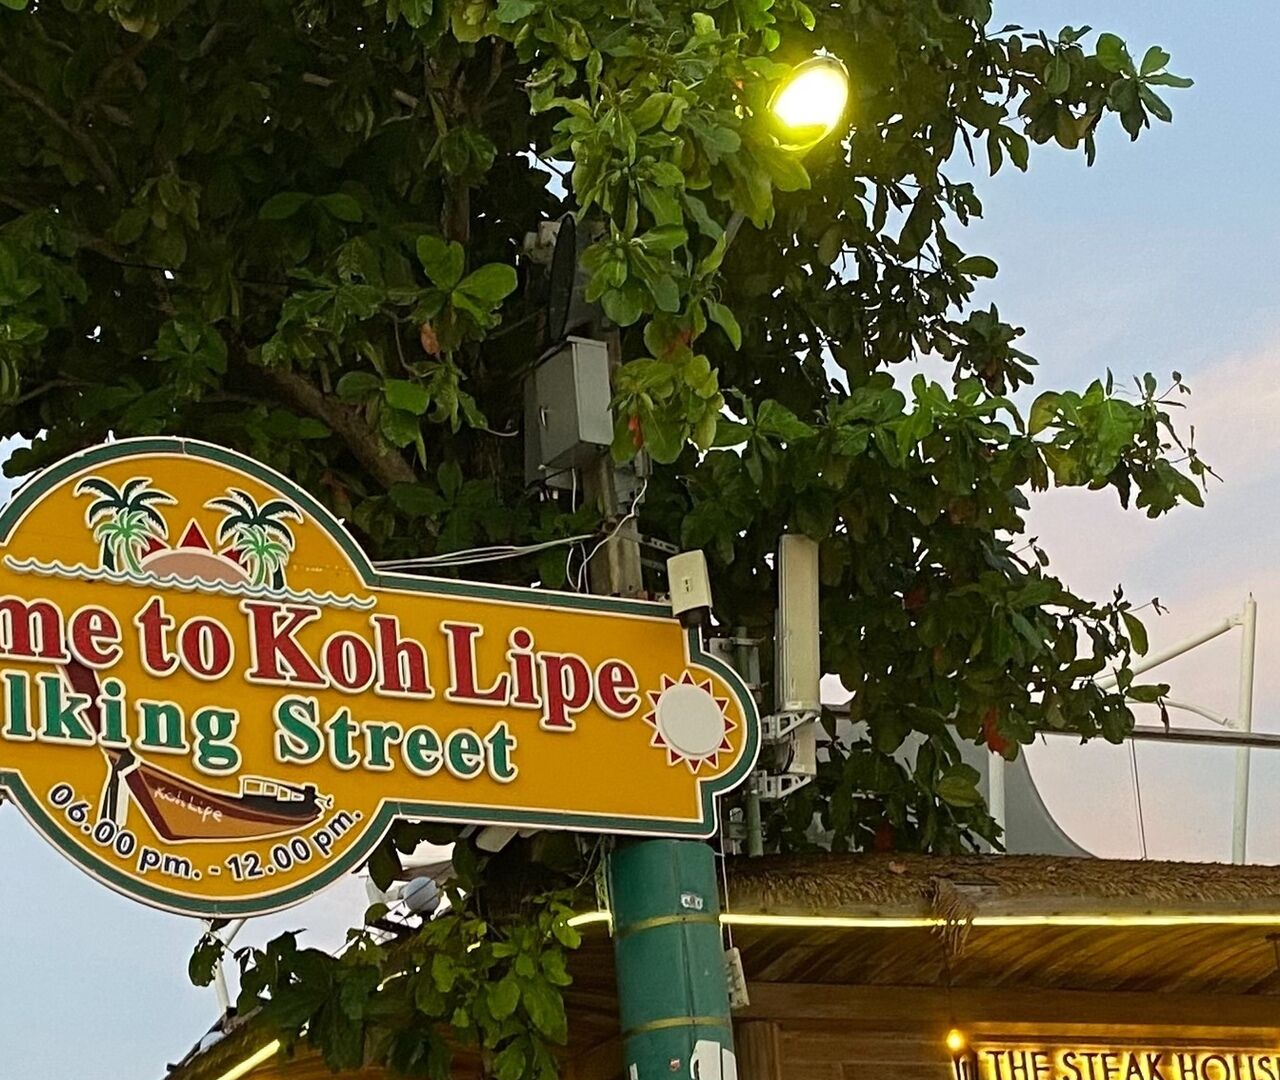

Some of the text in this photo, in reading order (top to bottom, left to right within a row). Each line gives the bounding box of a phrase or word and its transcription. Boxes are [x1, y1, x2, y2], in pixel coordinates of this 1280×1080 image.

[134, 596, 233, 682] to
[240, 598, 435, 700] Koh
[441, 620, 641, 732] Lipe
[272, 694, 519, 783] Street
[48, 783, 137, 857] 06.00
[137, 847, 203, 880] pm.
[227, 838, 312, 881] 12.00
[310, 808, 364, 855] pm.
